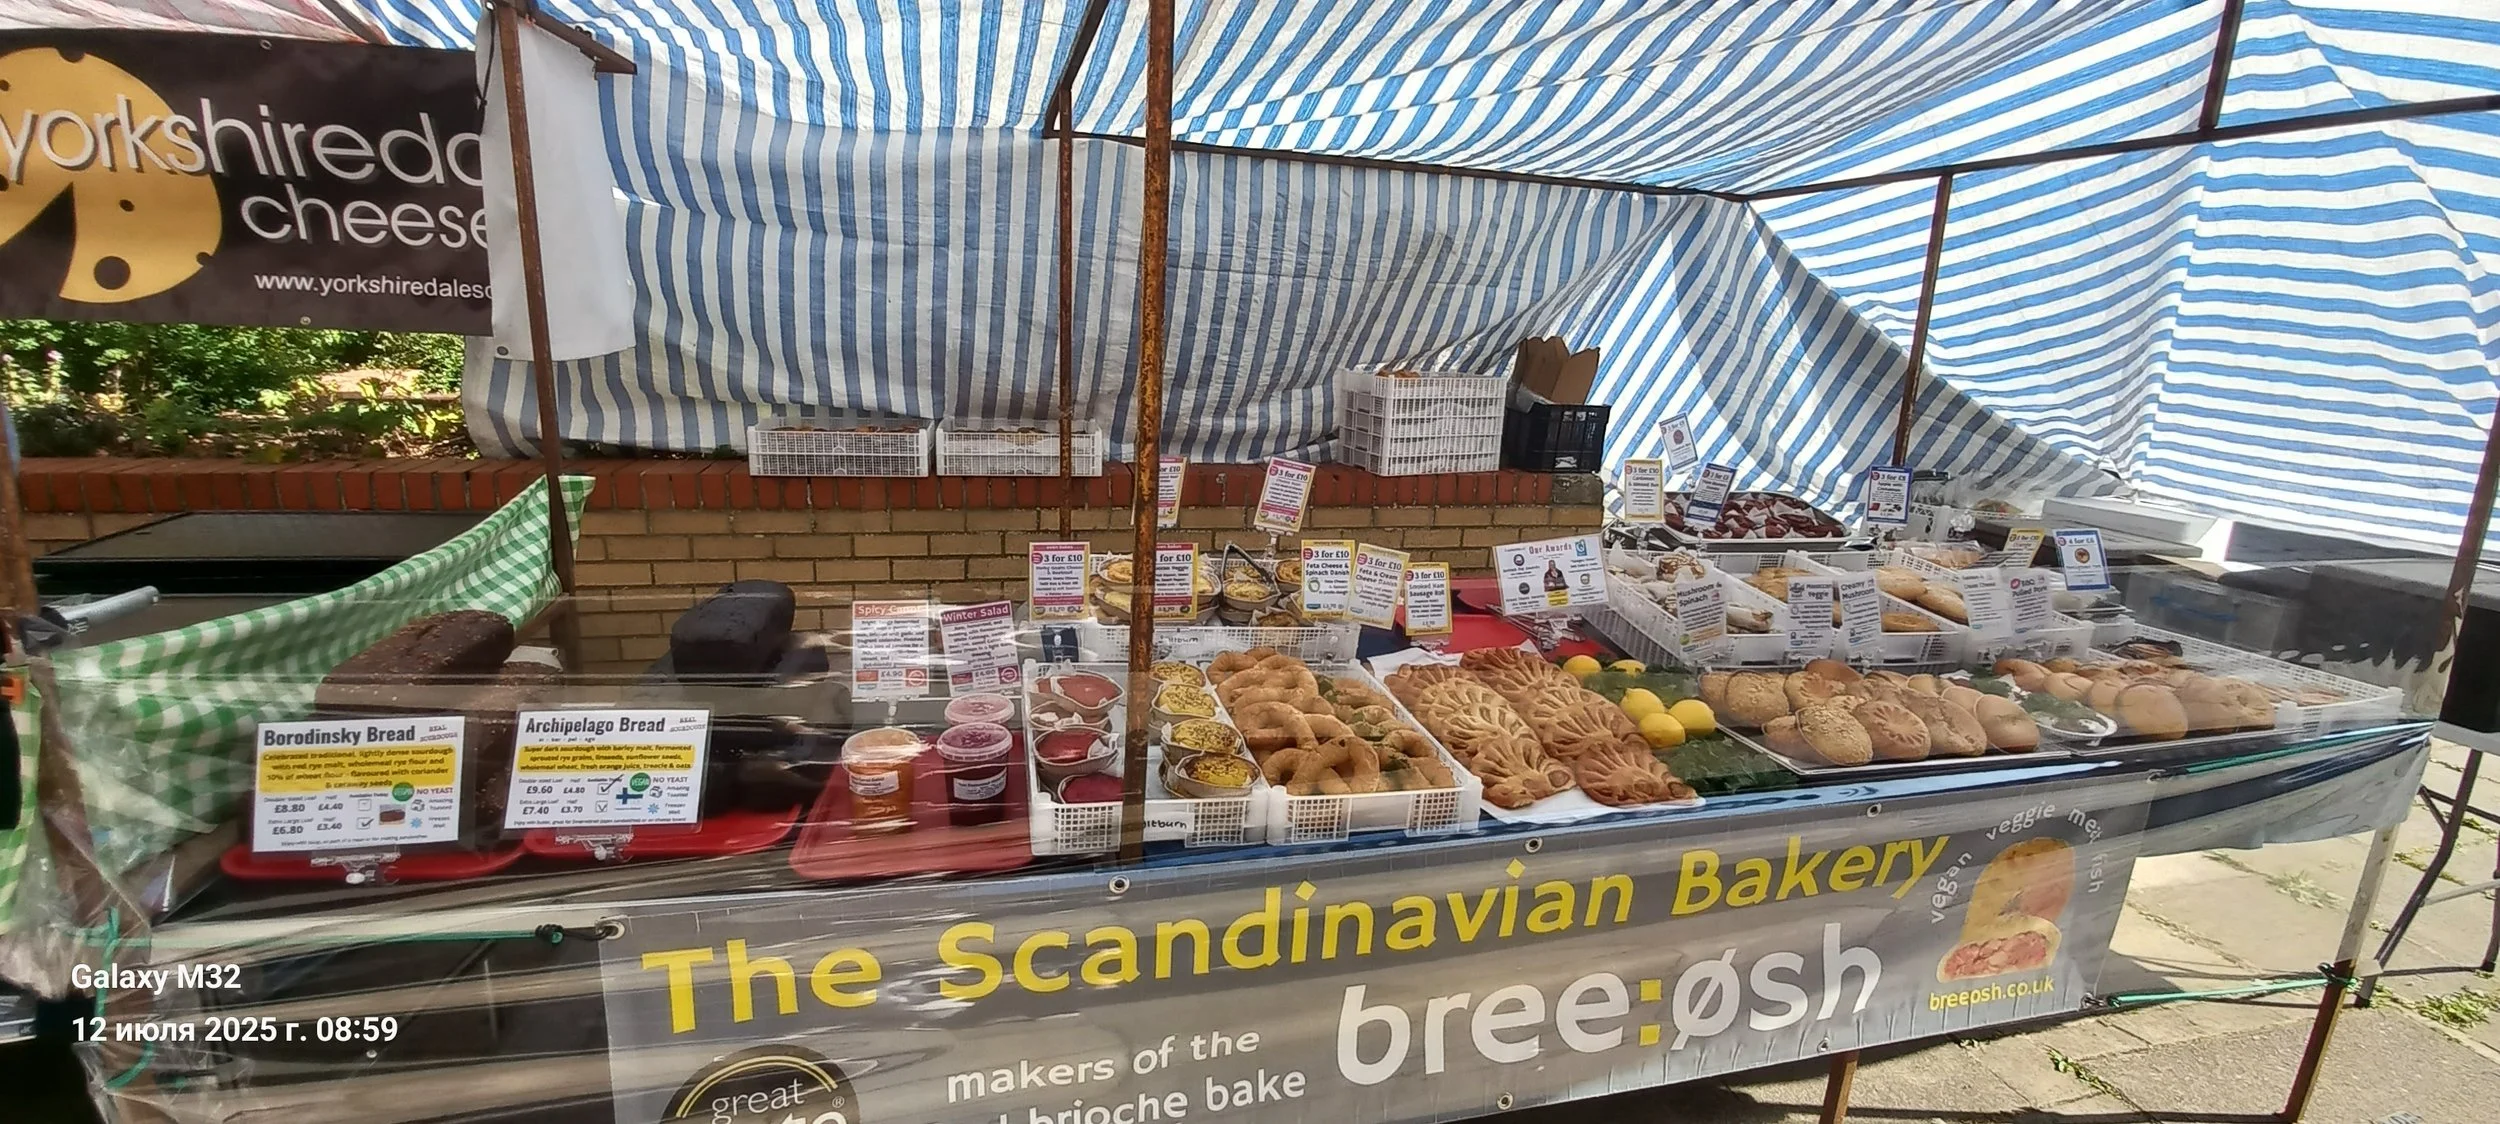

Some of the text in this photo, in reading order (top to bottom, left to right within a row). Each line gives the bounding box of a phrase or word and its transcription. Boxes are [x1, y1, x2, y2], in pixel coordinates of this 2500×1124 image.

[1285, 470, 1295, 478] for
[1297, 472, 1308, 480] £10
[1529, 546, 1542, 554] Our
[1545, 542, 1572, 553] Awards
[1044, 554, 1083, 562] 3 for £10
[1160, 554, 1191, 562] for £10
[1321, 550, 1334, 558] for
[1336, 550, 1349, 558] £10
[1374, 558, 1387, 567] for
[1388, 562, 1402, 570] £10
[1355, 574, 1377, 583] Cheese
[1379, 572, 1398, 580] Cream
[1677, 584, 1714, 597] Mushroom
[1841, 581, 1865, 591] Creamy
[1842, 588, 1875, 599] Mushroom
[1679, 594, 1708, 607] Spinach
[858, 605, 887, 616] Spicy
[943, 605, 1009, 622] Winter Salad
[525, 717, 666, 736] Archipelago Bread
[264, 725, 416, 746] Borodinsky Bread
[386, 747, 410, 756] dense
[411, 747, 454, 756] sourdough
[560, 745, 595, 753] sourdough
[348, 759, 392, 767] wholemeal
[429, 757, 445, 765] and
[351, 769, 390, 777] flavoured
[370, 779, 393, 787] seeds
[526, 785, 553, 794] £9.60
[563, 786, 586, 794] £4.80
[274, 803, 305, 813] £8.80
[318, 802, 344, 811] £4.40
[522, 806, 549, 815] £7.40
[272, 825, 304, 835] £6.80
[316, 822, 342, 831] £3.40
[1930, 851, 1973, 924] vegan
[1985, 801, 2056, 841] veggie
[642, 837, 1950, 1034] The Scandinavian Bakery
[1336, 922, 1883, 1087] bree:øsh
[947, 1031, 1261, 1103] makers of the
[711, 1078, 804, 1124] great
[1030, 1068, 1307, 1124] brioche bake
